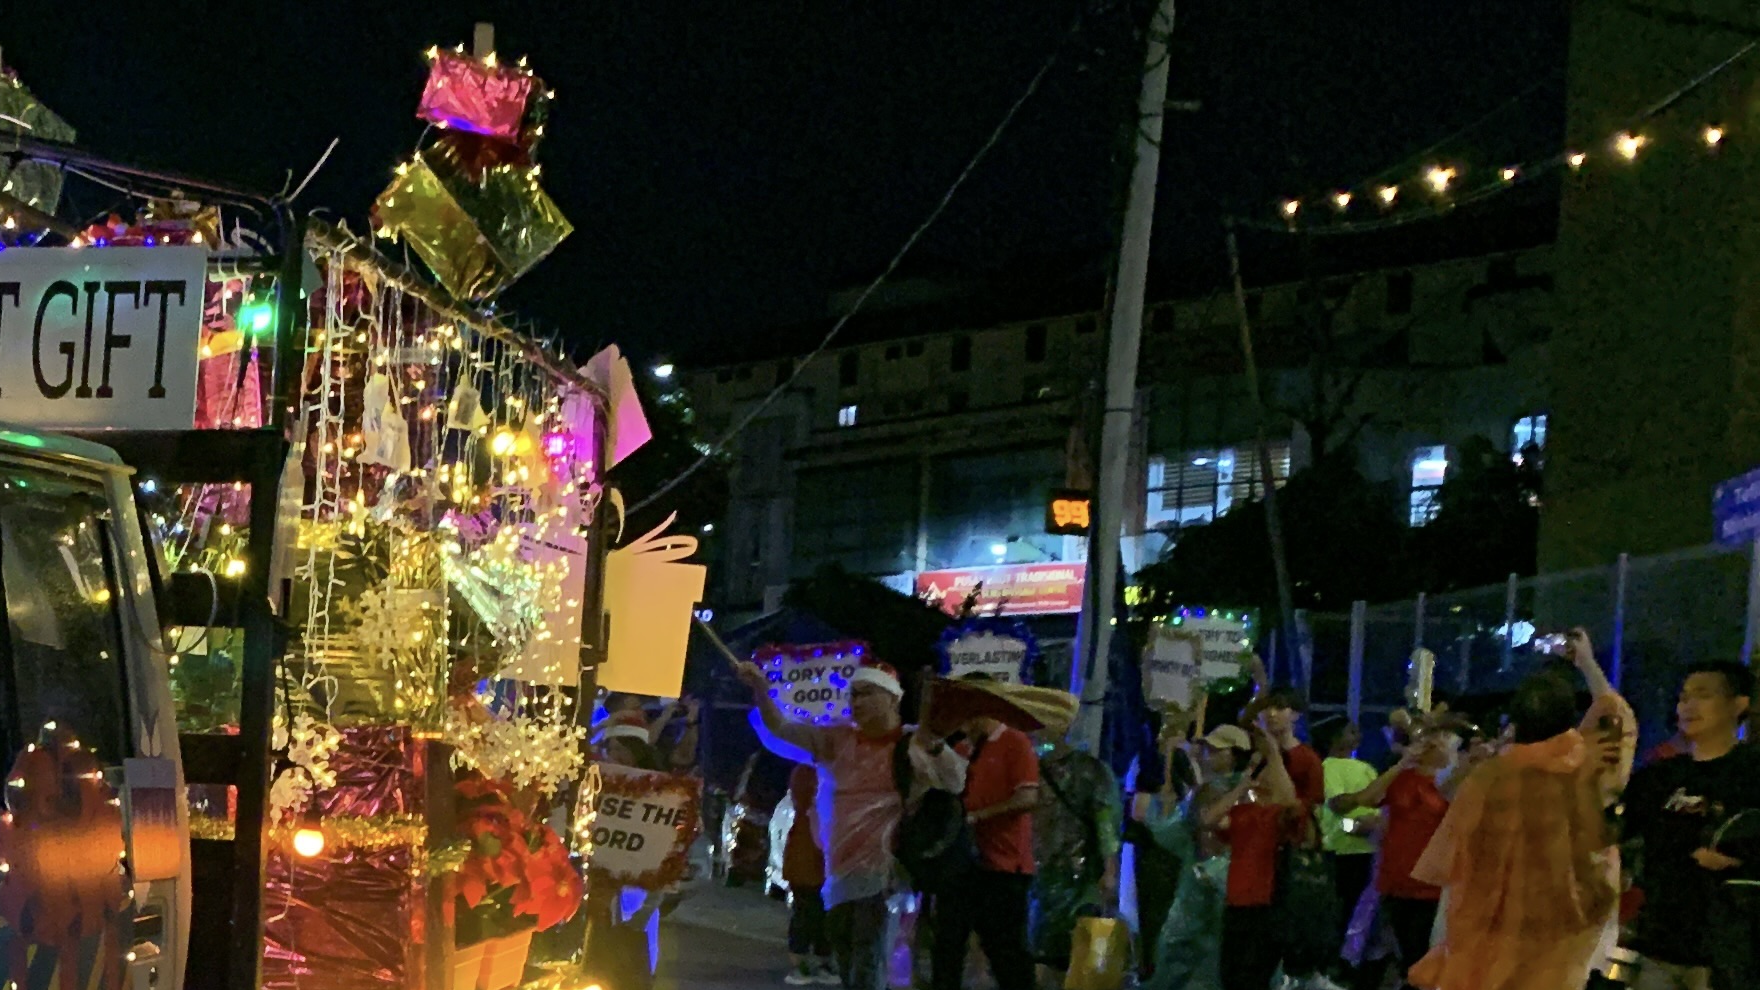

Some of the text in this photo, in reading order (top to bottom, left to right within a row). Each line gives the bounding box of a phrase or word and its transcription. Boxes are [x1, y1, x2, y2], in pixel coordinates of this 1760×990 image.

[32, 279, 187, 400] GIFT
[641, 802, 689, 828] THE
[590, 825, 645, 852] ORD
